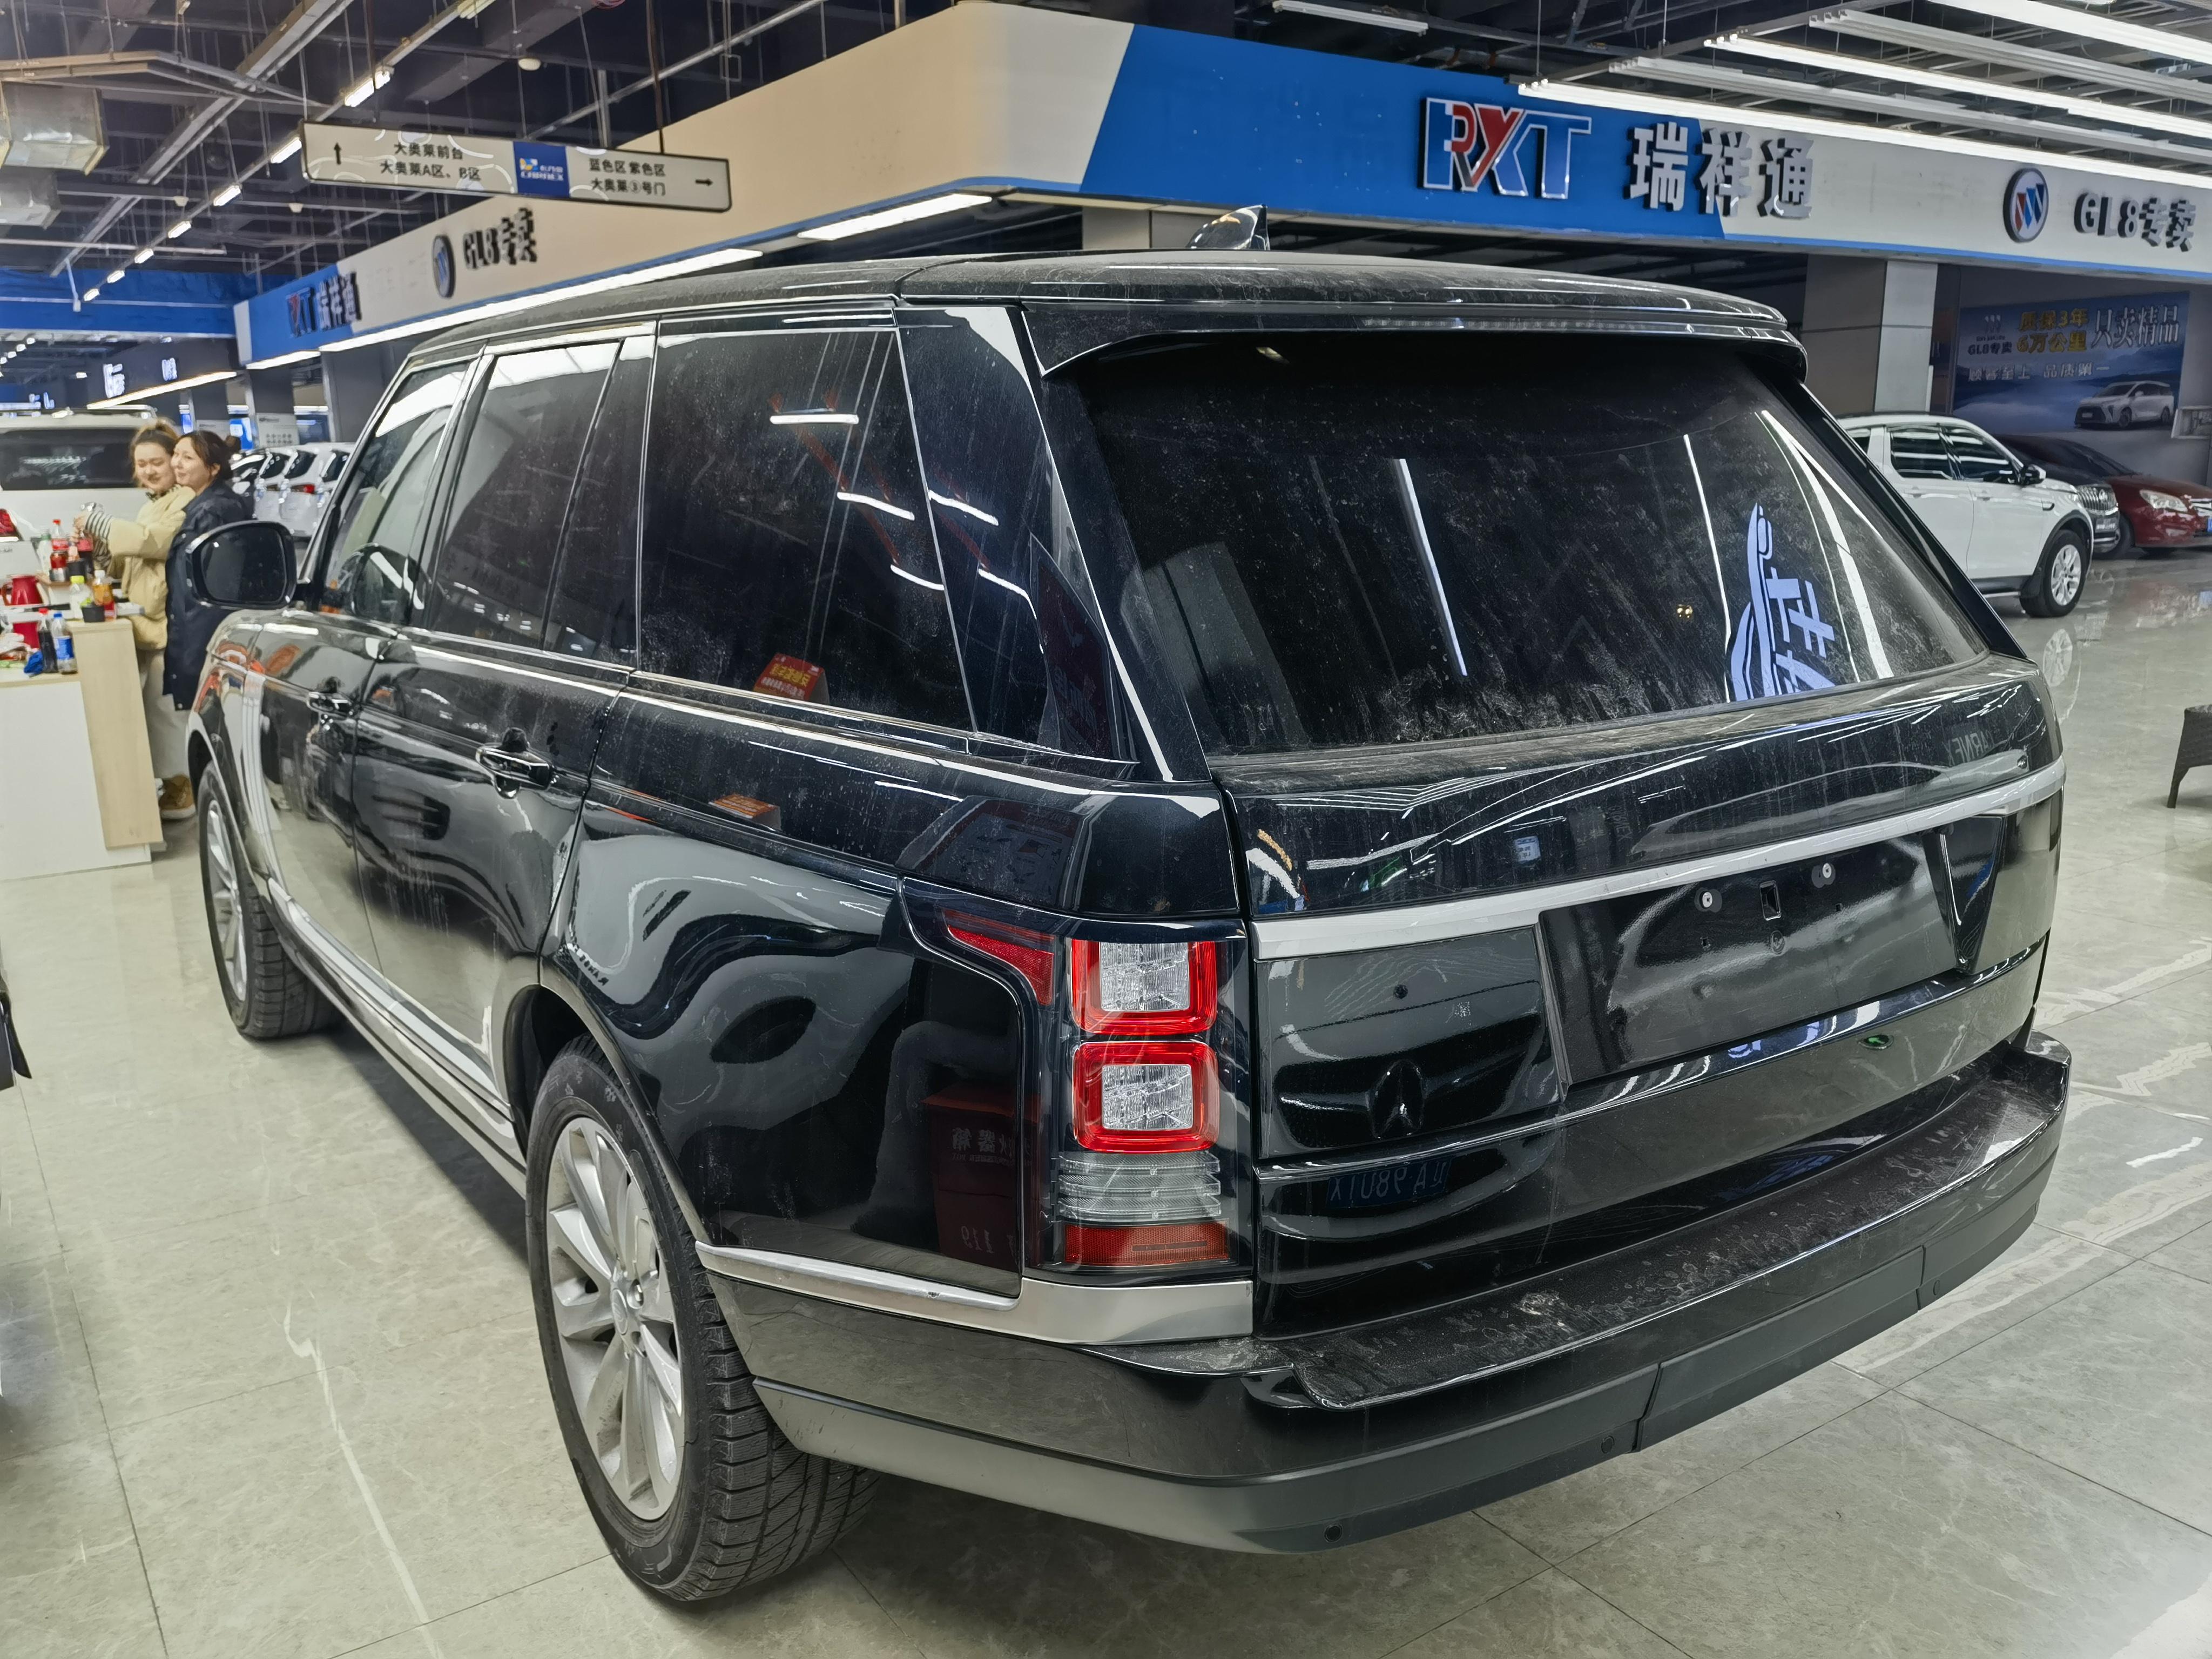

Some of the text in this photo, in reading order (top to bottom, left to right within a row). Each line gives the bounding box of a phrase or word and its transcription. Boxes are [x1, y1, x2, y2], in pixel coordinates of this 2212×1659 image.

[394, 141, 463, 160] 大奥莱前台
[589, 157, 666, 177] 蓝色区 紫色区
[1623, 121, 1814, 218] 瑞祥通
[2074, 192, 2197, 252] GL8专卖
[2017, 330, 2087, 354] 6万公里
[2091, 305, 2179, 349] 只卖精品
